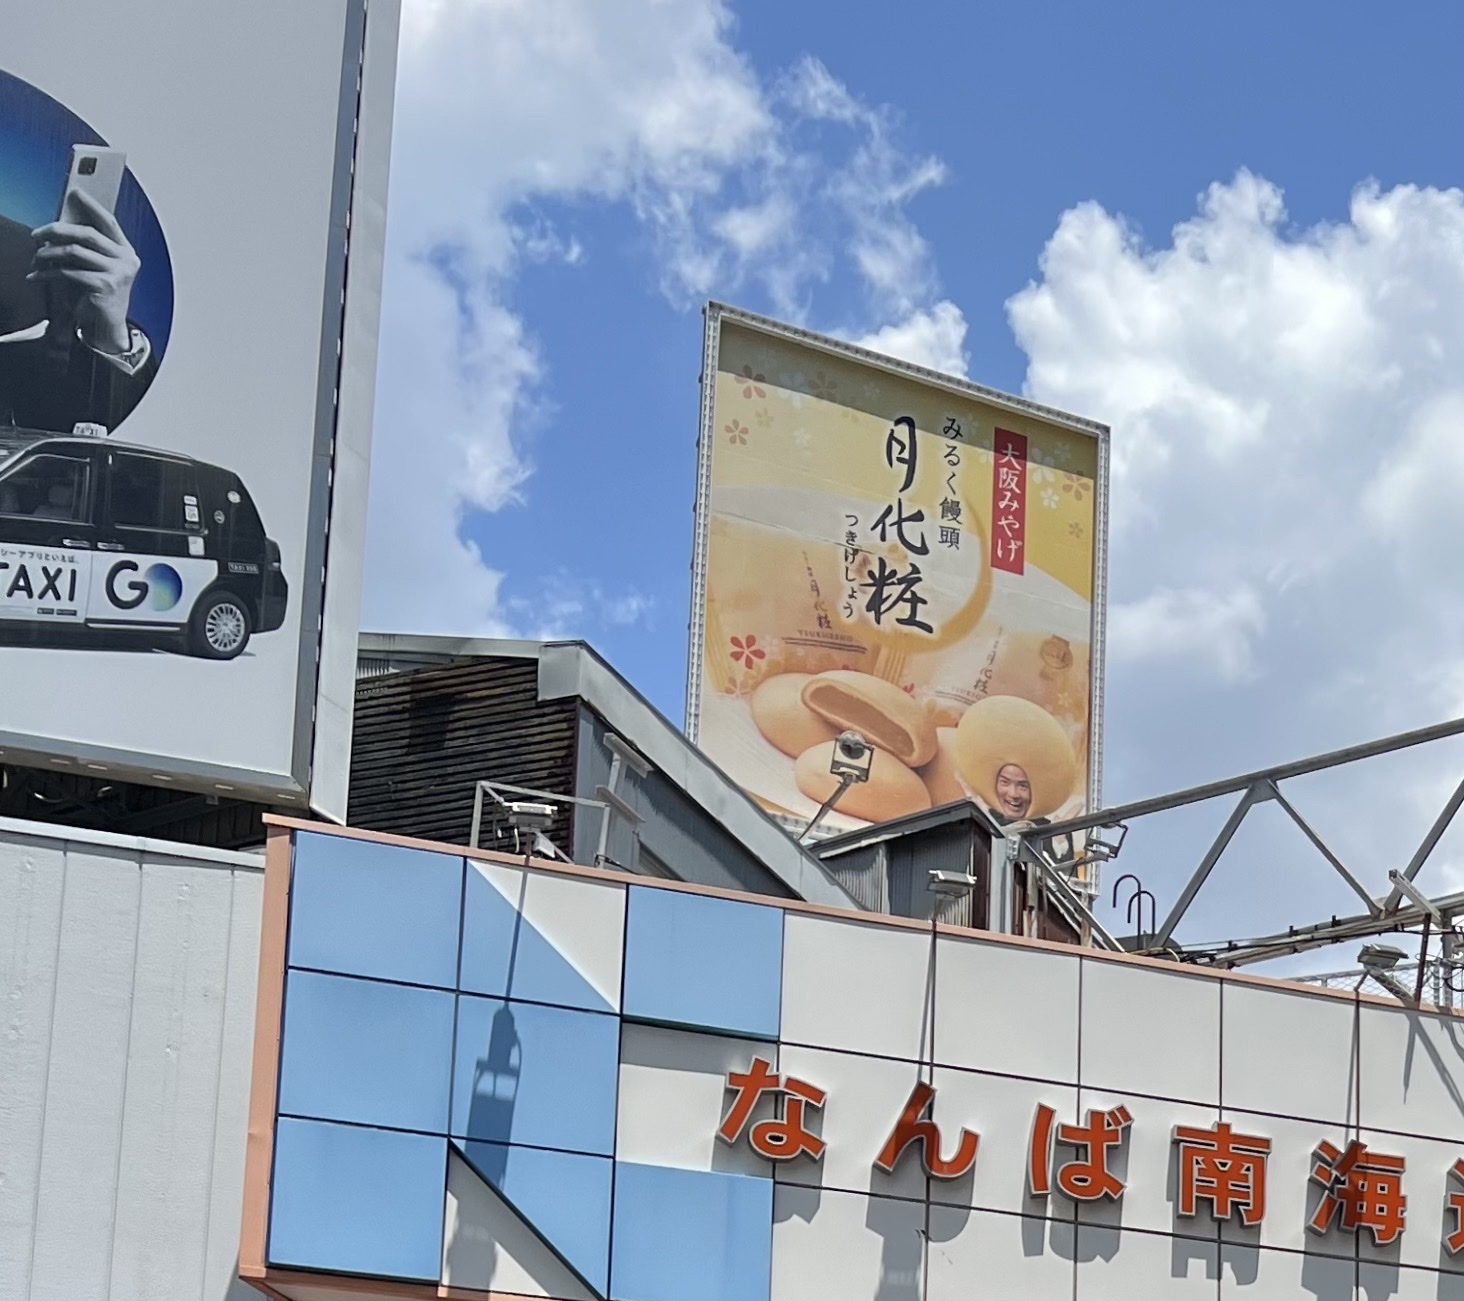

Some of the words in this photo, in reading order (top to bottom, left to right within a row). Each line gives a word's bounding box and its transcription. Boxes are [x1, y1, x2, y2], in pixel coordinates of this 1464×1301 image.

[865, 415, 935, 635] 月化粧
[937, 415, 964, 551] みるく饅頭
[995, 443, 1023, 563] 大阪みやげ
[842, 512, 859, 619] つきげしょう
